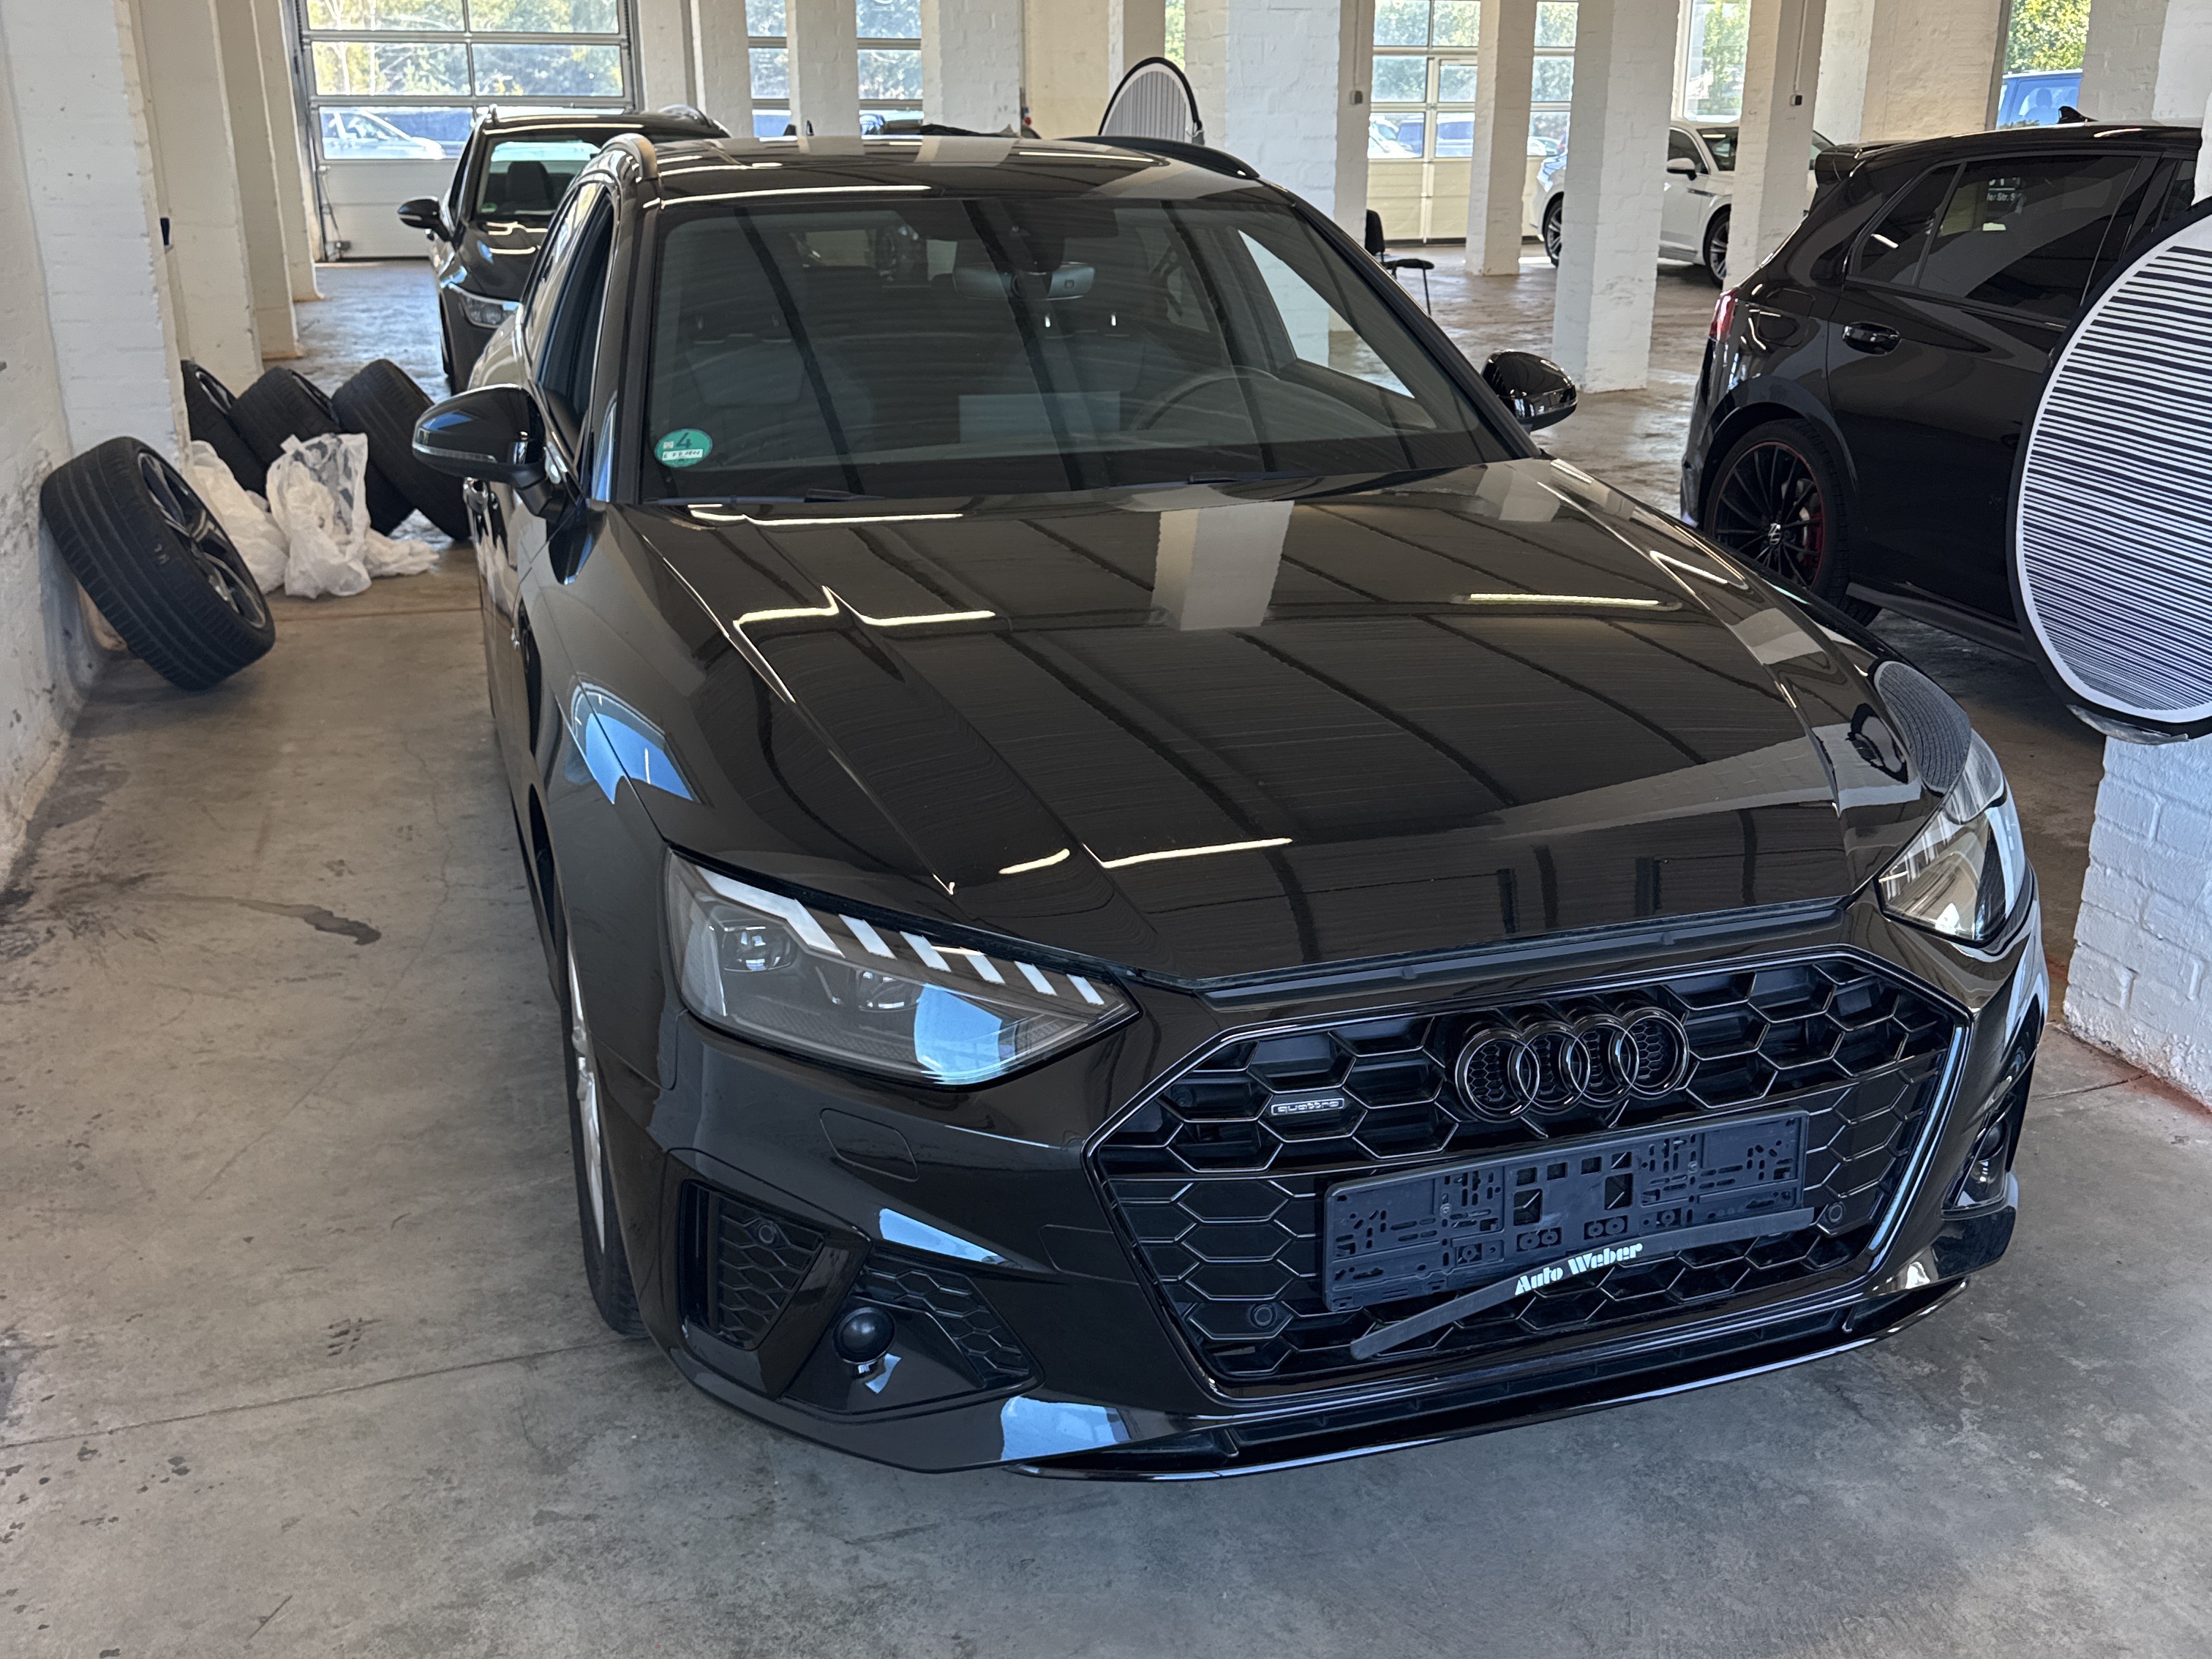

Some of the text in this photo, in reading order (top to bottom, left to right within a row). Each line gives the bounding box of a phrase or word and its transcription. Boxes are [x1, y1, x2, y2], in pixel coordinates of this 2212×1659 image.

[677, 432, 691, 448] 4
[1277, 1101, 1339, 1113] quattro
[1515, 1243, 1643, 1295] Auto Weber
